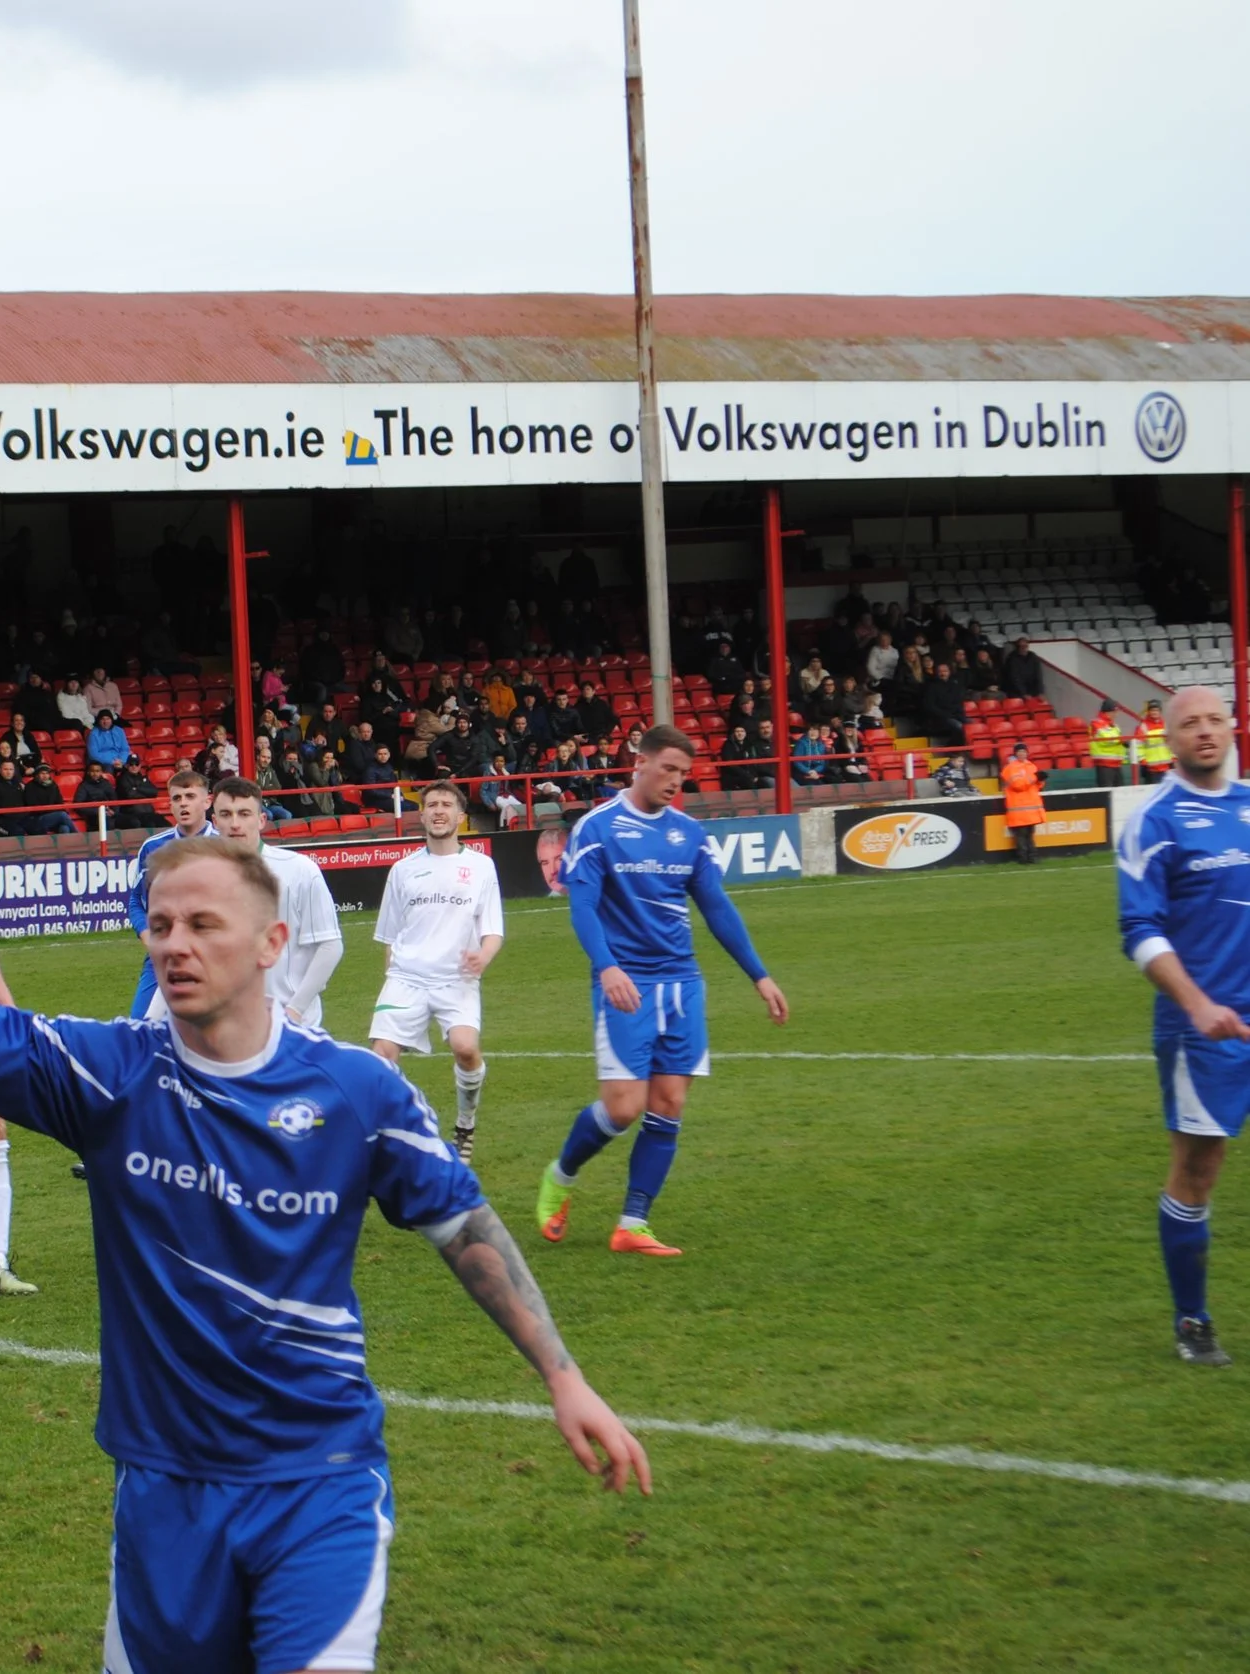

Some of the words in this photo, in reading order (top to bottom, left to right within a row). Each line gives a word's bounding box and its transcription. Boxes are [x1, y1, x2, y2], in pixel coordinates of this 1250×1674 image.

[374, 406, 453, 456] The
[471, 406, 593, 456] home
[610, 422, 642, 453] o
[665, 402, 918, 463] Volkswagen
[934, 406, 967, 449] in
[983, 402, 1107, 449] Dublin
[330, 850, 340, 864] of
[341, 850, 373, 865] Deputy
[374, 847, 401, 861] Finian
[39, 903, 70, 918] Lane,
[72, 899, 127, 915] Malahide,
[44, 921, 64, 935] 845
[65, 920, 91, 934] 0657
[102, 918, 121, 931] 086
[125, 1151, 339, 1215] oneills.com
